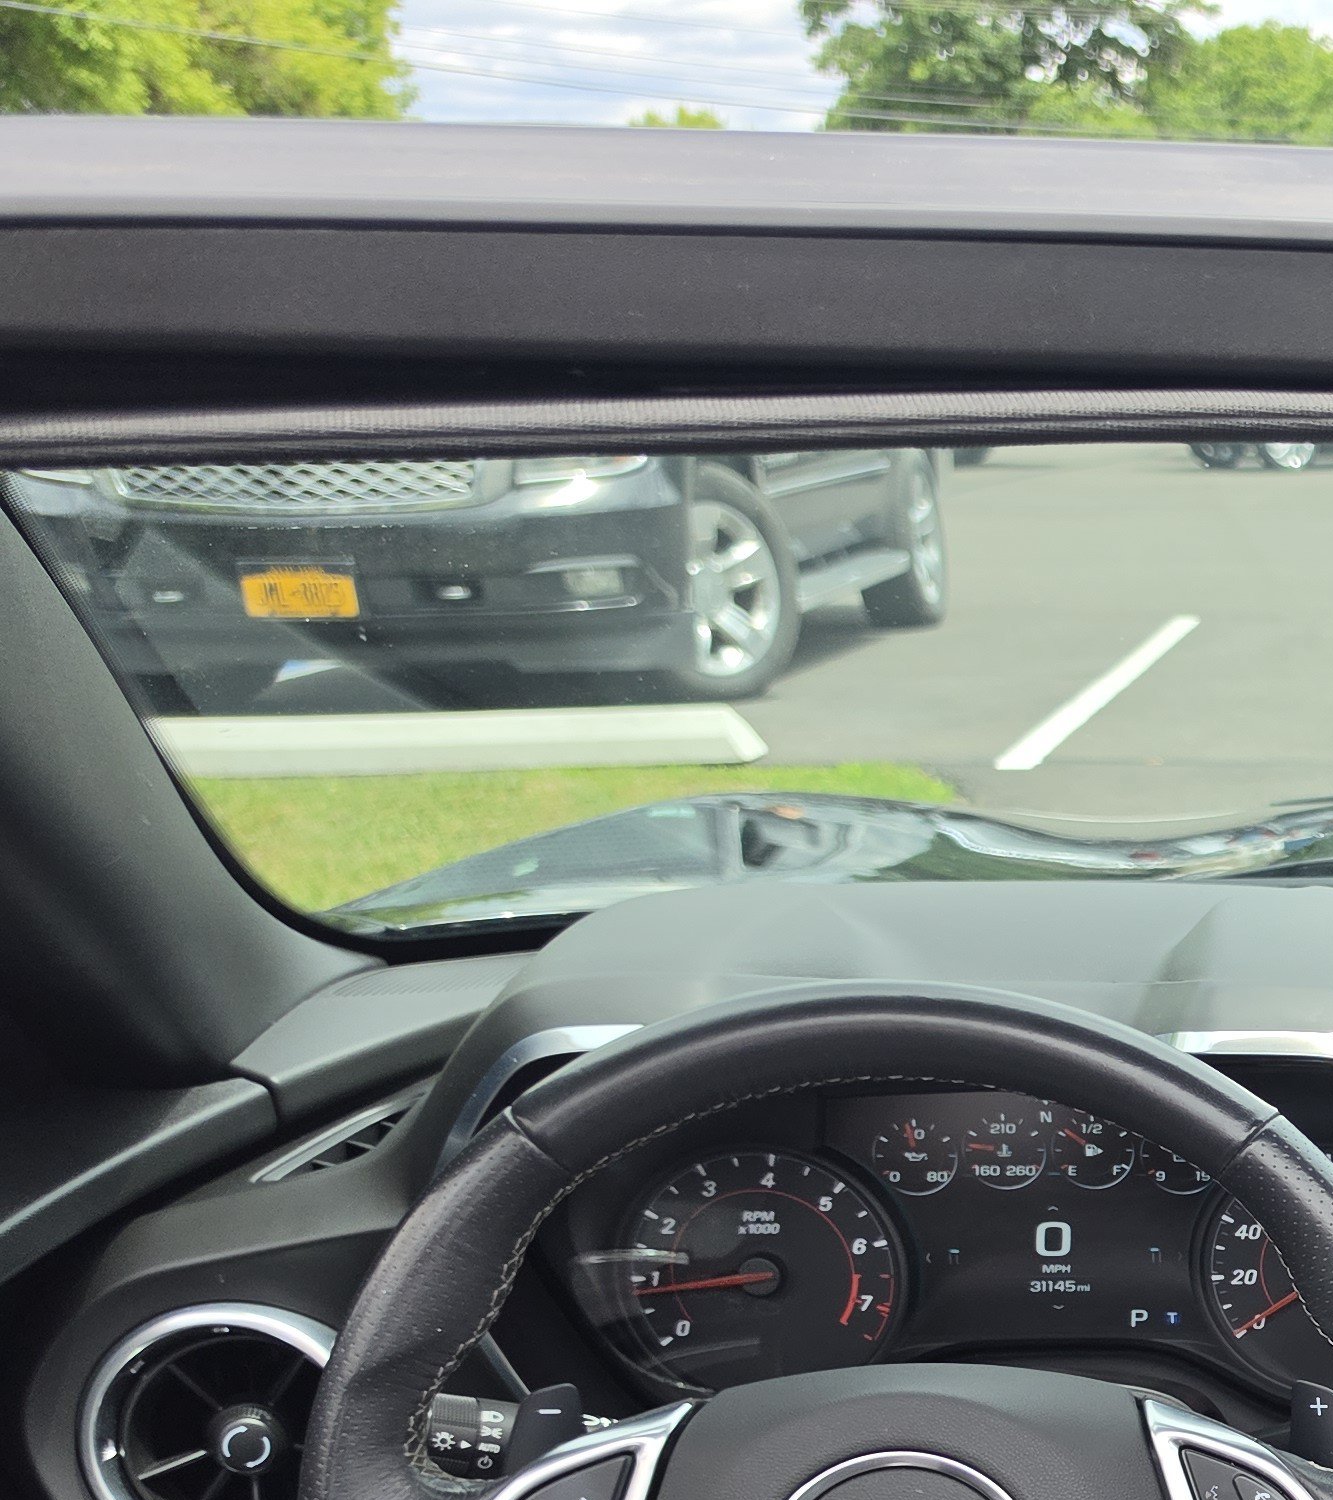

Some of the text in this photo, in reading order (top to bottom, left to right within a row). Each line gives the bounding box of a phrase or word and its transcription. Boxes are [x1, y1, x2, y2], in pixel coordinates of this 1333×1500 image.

[1040, 1111, 1052, 1123] N
[989, 1123, 1016, 1134] 210
[1081, 1123, 1102, 1134] 1/2
[889, 1171, 949, 1183] 0 80
[974, 1165, 1036, 1177] 160 260
[1067, 1165, 1122, 1177] E F
[1155, 1171, 1166, 1182] 9
[760, 1172, 776, 1189] 4
[702, 1181, 717, 1198] 3
[817, 1196, 833, 1212] 5
[742, 1210, 775, 1222] RPM
[661, 1218, 677, 1235] 2
[1234, 1224, 1262, 1240] 40
[852, 1238, 867, 1255] 6
[1035, 1221, 1072, 1257] 0
[1041, 1264, 1072, 1274] MPH
[1230, 1269, 1258, 1285] 20
[650, 1271, 661, 1287] 1
[861, 1294, 874, 1312] 7
[1130, 1309, 1149, 1328] P
[675, 1320, 691, 1337] 0
